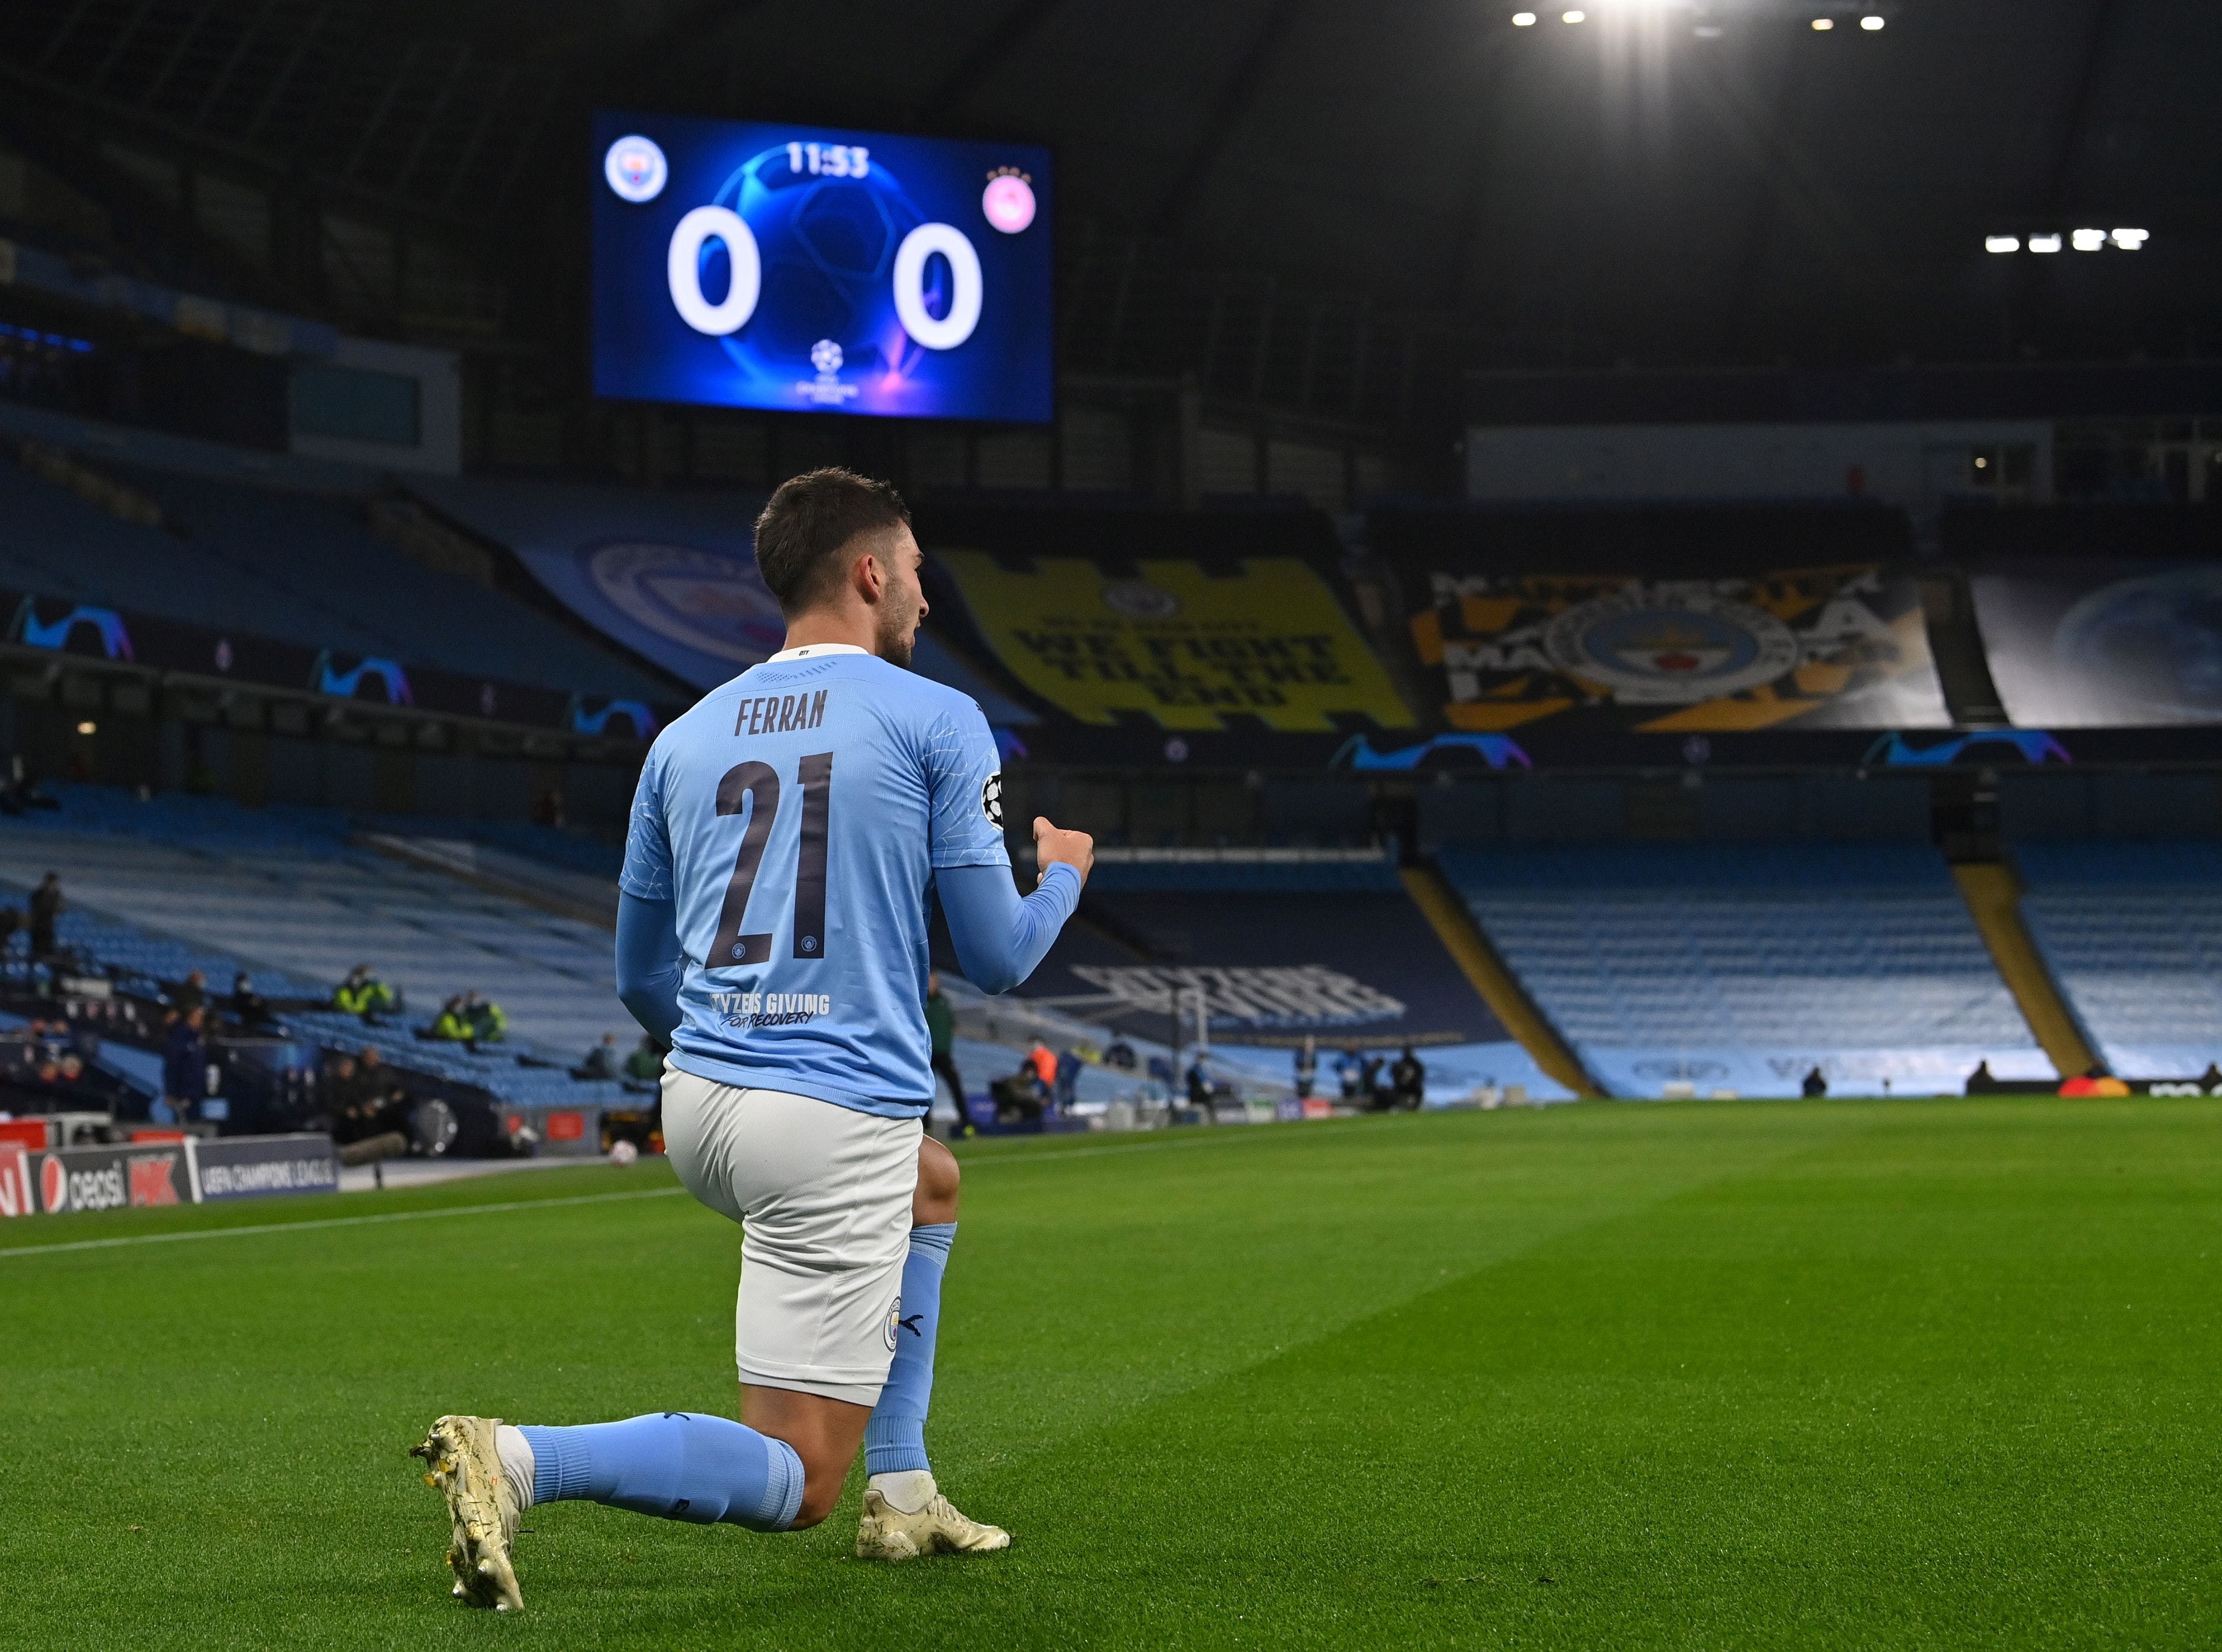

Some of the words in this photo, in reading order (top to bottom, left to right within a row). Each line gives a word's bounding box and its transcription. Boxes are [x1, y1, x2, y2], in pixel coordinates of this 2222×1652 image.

[786, 142, 870, 179] 11:53
[667, 205, 762, 337] 0
[893, 223, 983, 351] 0
[734, 689, 828, 737] FERRAN
[704, 751, 833, 969] 21
[747, 1011, 814, 1029] RECOVERY
[766, 993, 830, 1015] GIVING
[70, 1159, 126, 1212] pepsi
